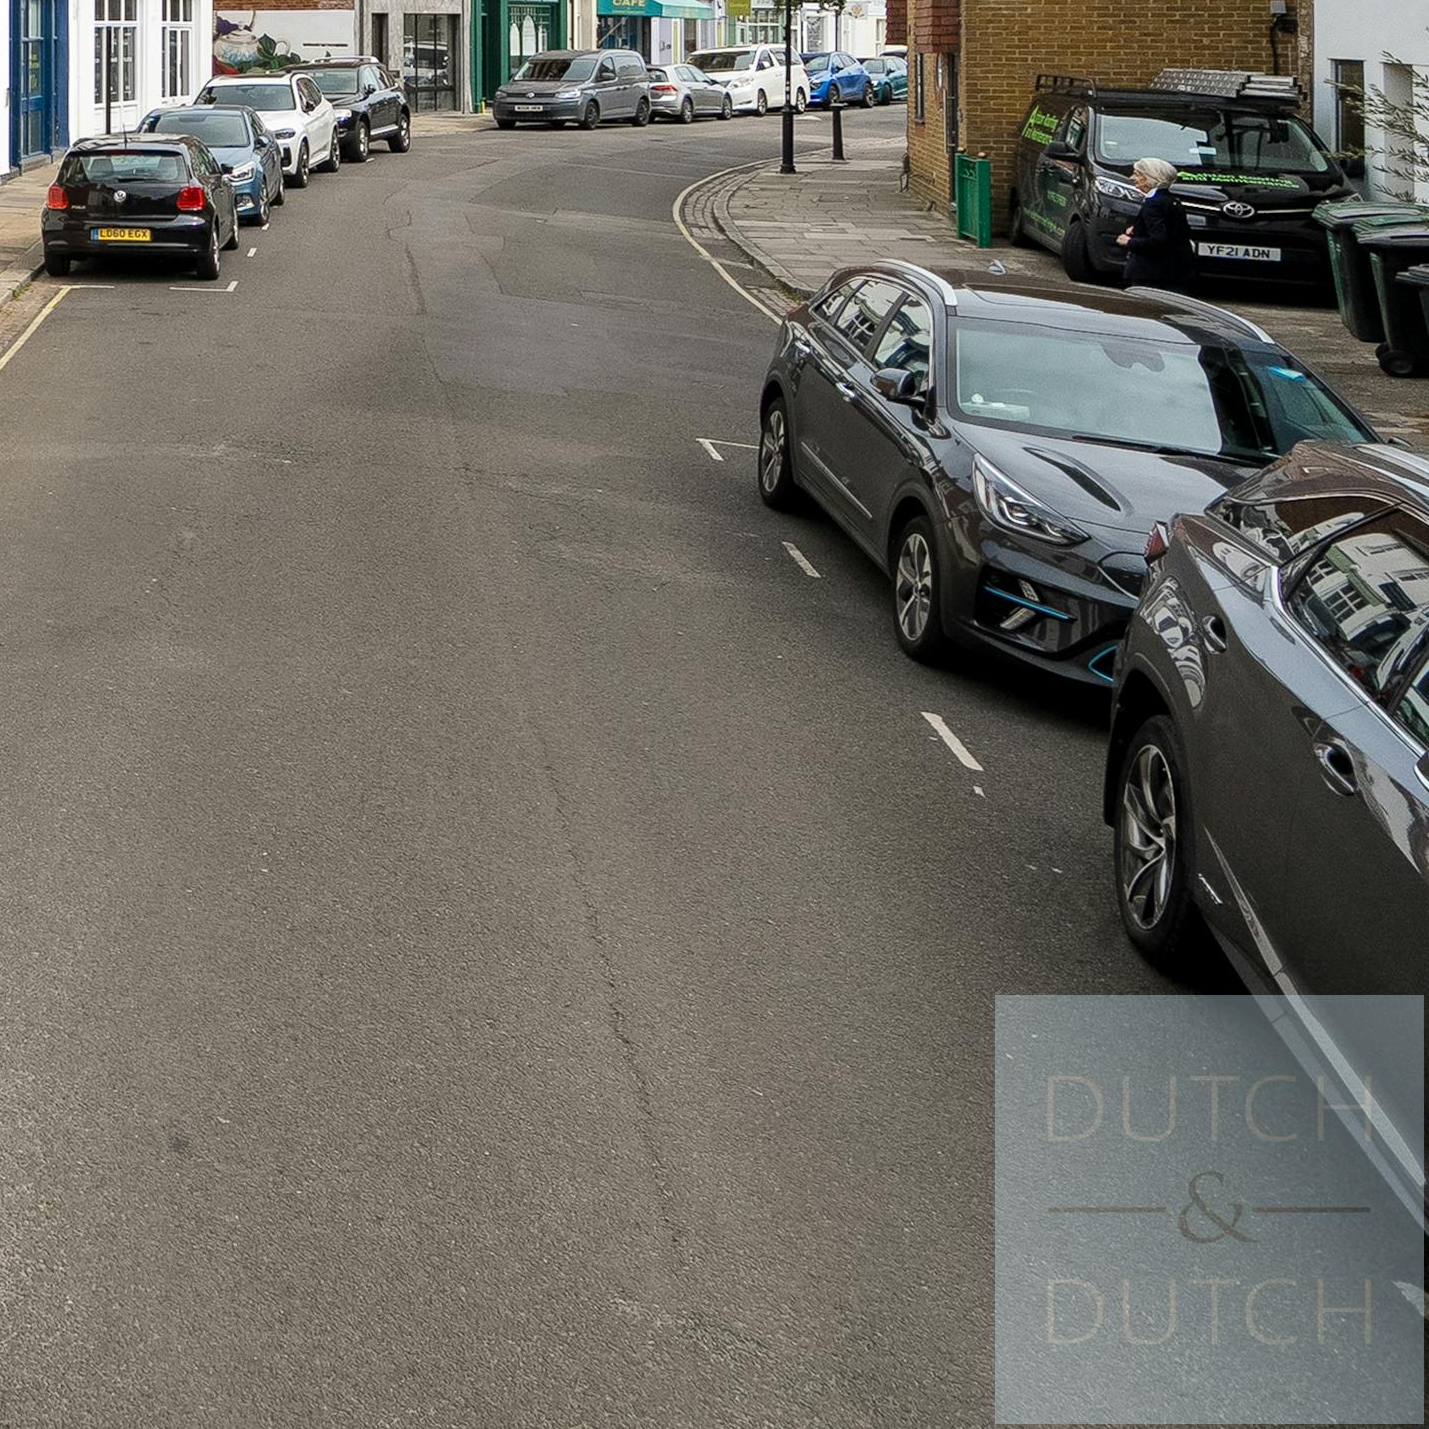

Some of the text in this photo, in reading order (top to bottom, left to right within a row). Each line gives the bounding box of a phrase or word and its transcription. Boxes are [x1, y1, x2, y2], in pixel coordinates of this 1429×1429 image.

[127, 230, 148, 239] EGX
[1207, 245, 1270, 259] YF21 ADN
